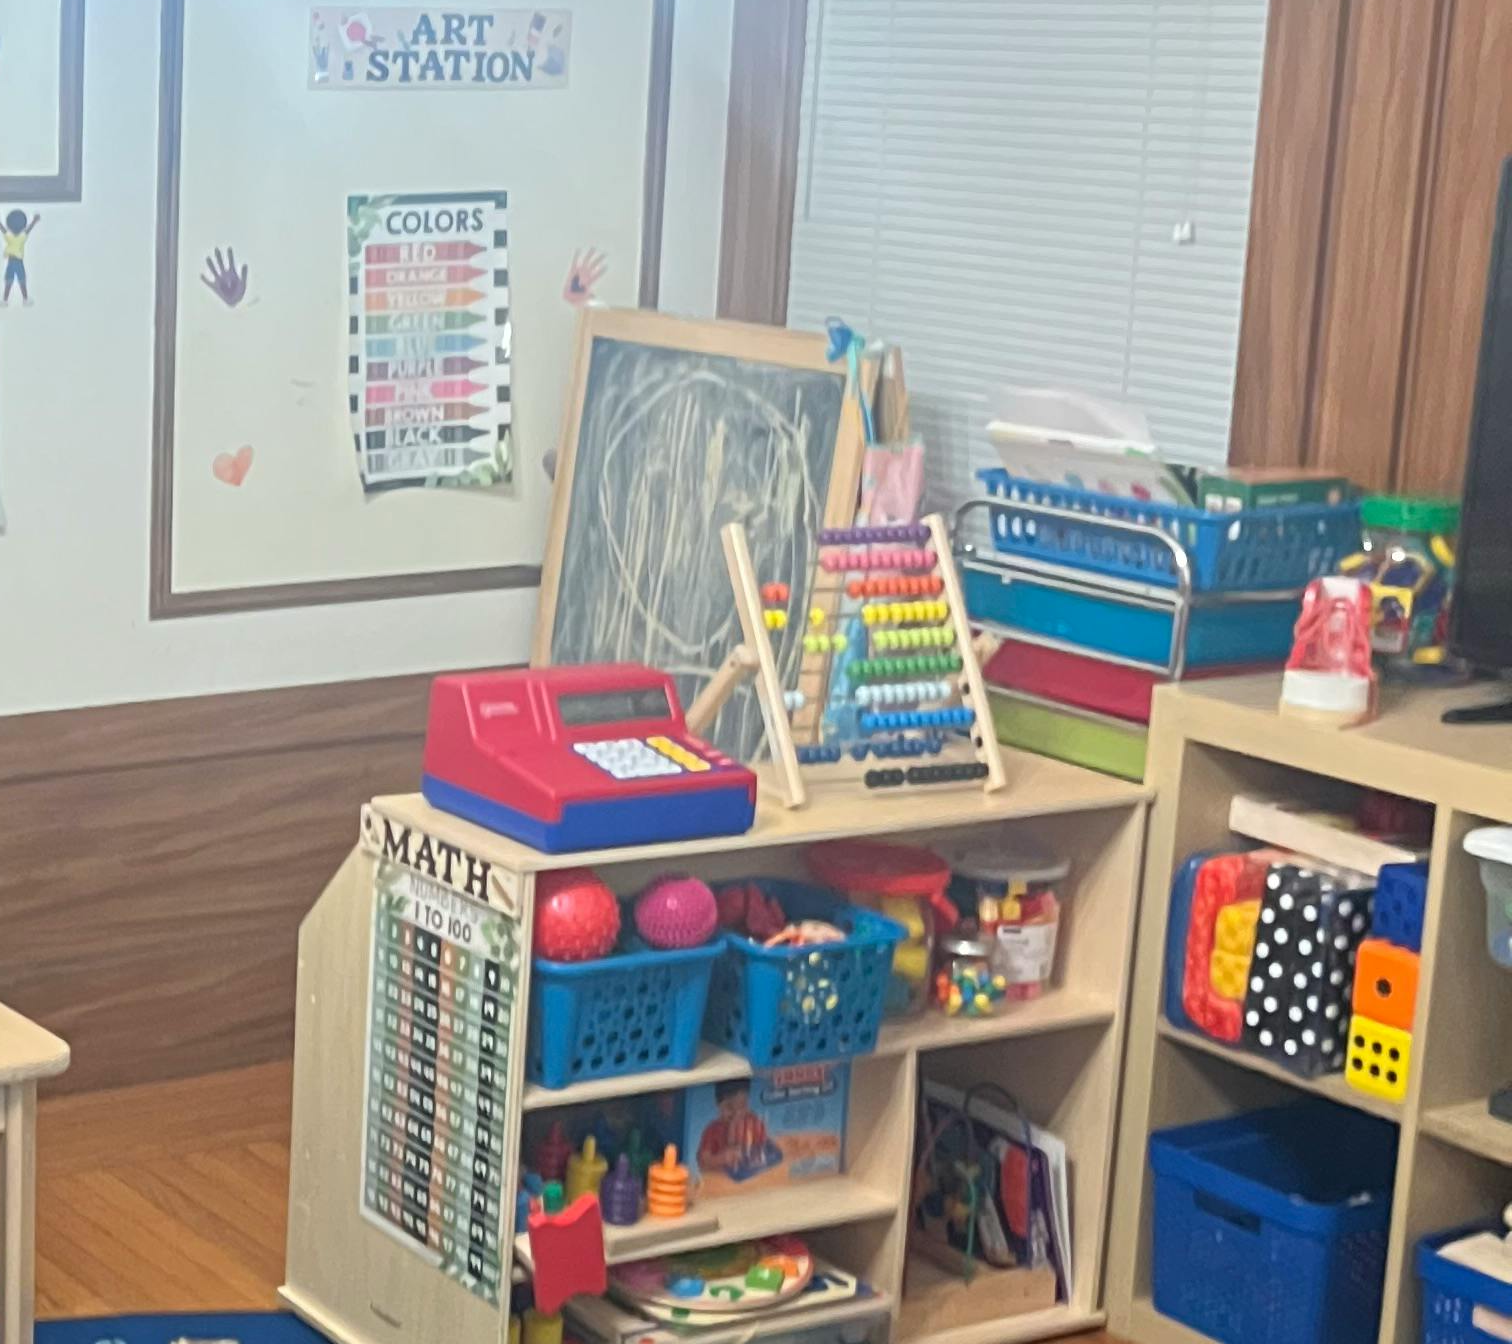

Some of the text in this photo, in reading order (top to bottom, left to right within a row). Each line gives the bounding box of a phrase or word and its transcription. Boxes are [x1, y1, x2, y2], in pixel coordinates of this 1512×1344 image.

[411, 13, 494, 46] ART
[366, 50, 536, 83] STATION
[387, 208, 484, 235] COLORS
[383, 819, 491, 902] MATH
[414, 901, 473, 943] 1 TO 100
